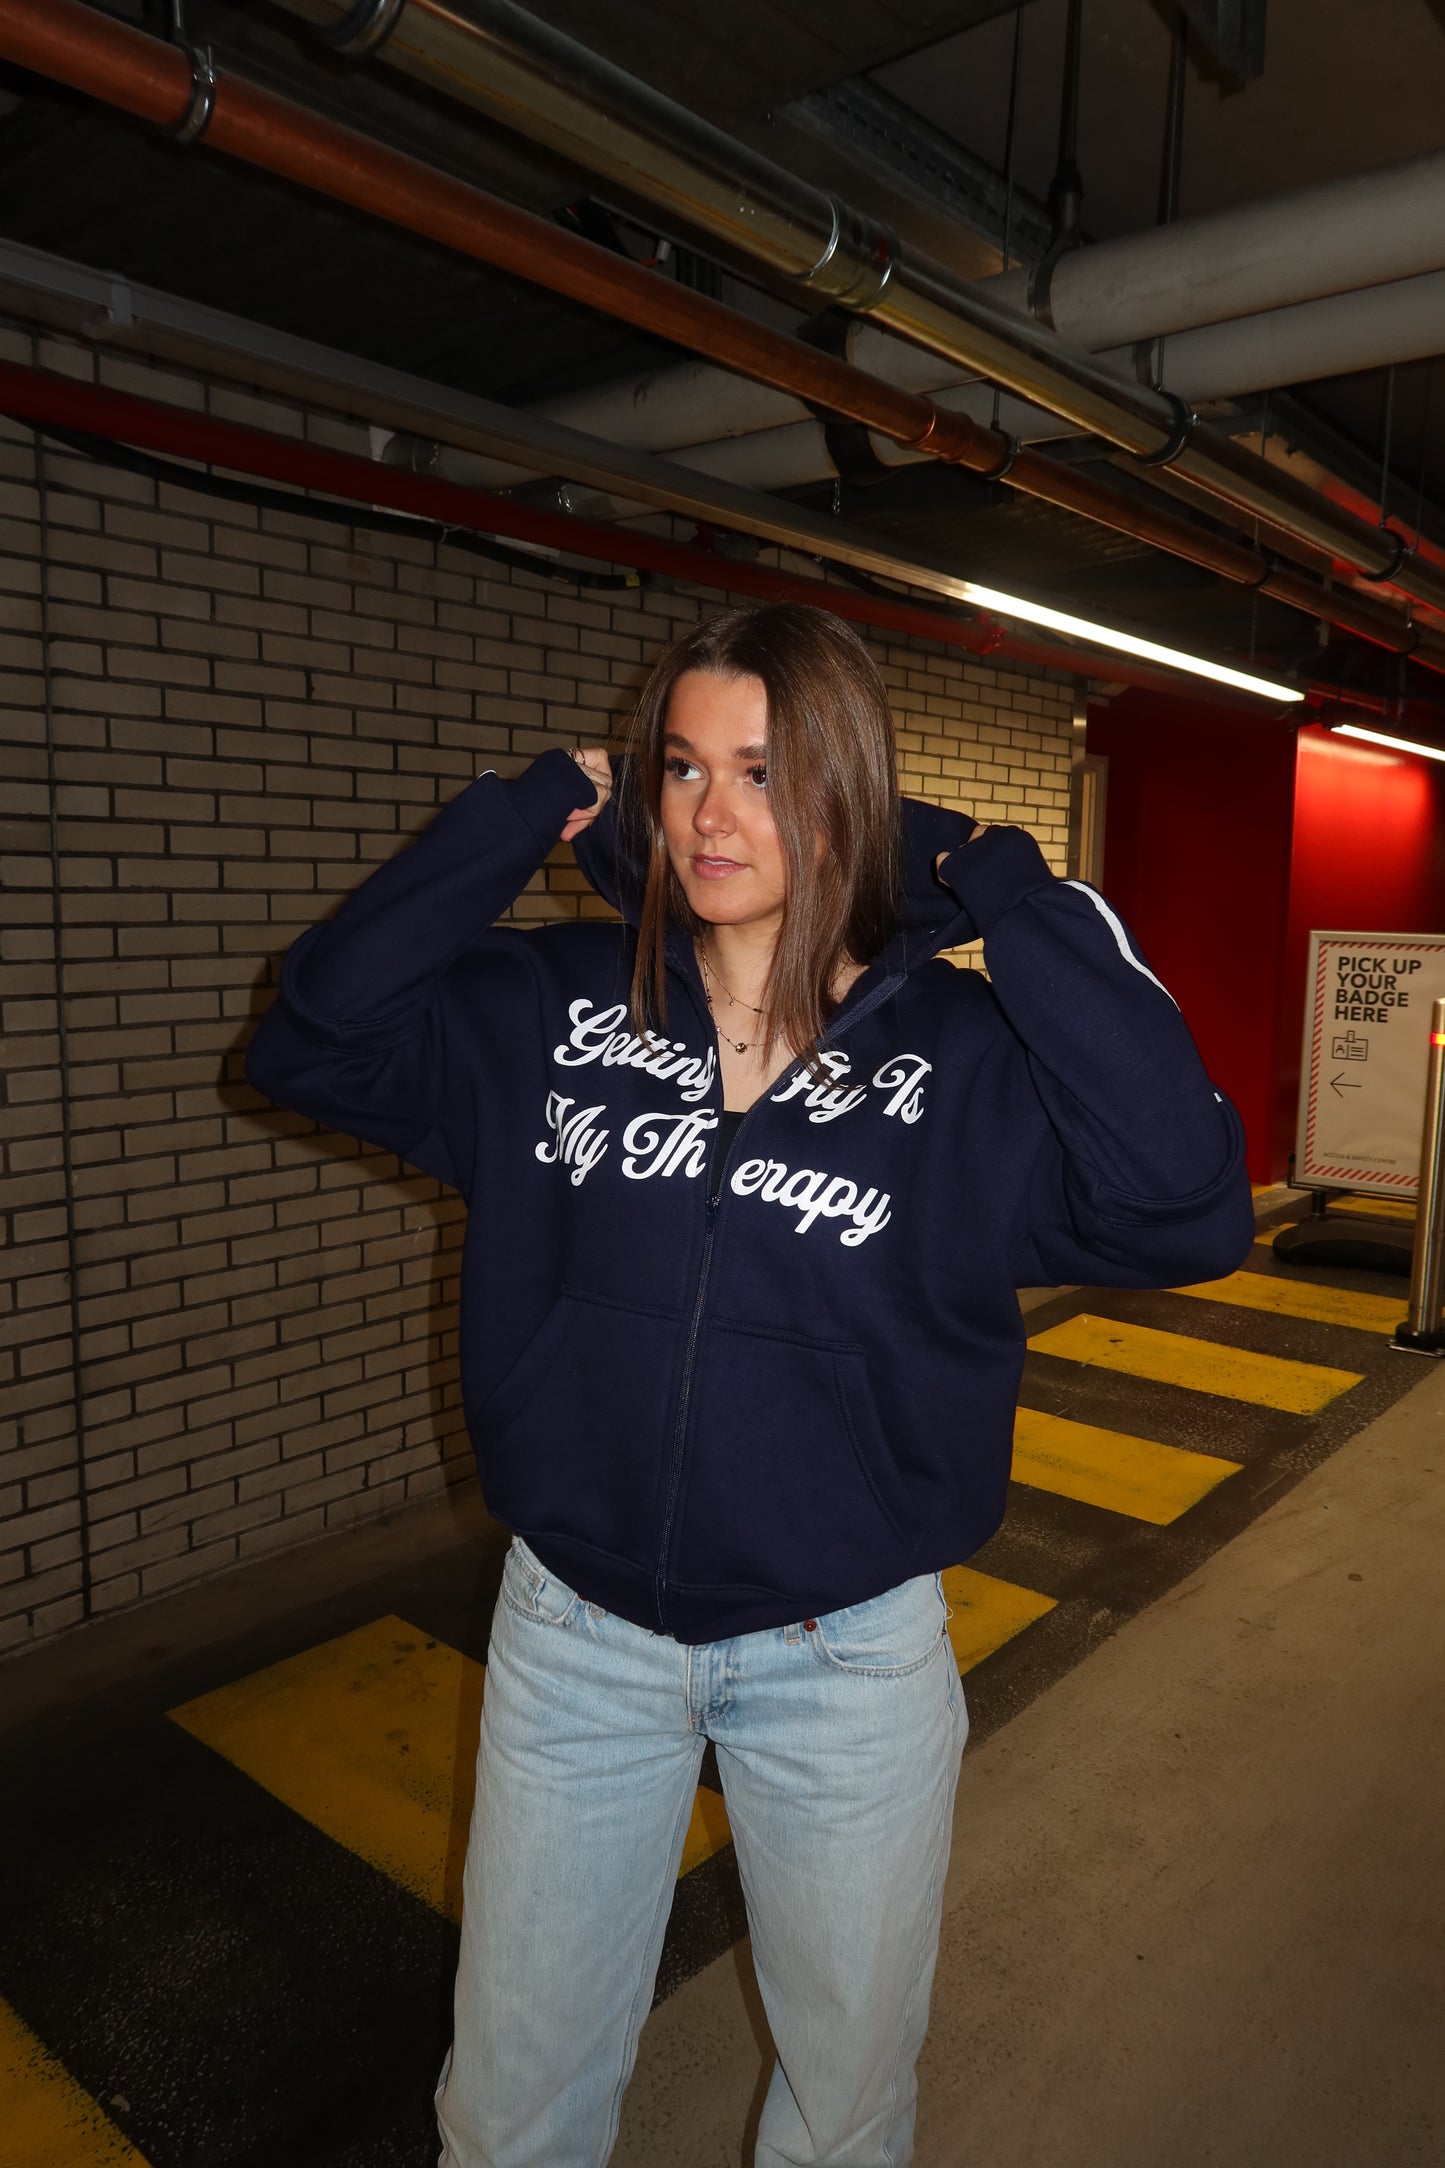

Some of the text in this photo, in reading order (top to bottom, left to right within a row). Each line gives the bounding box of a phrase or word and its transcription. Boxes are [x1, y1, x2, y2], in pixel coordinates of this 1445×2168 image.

[1338, 956, 1422, 975] PICK UP
[1336, 972, 1397, 990] YOUR
[1336, 989, 1409, 1007] BADGE
[1335, 1006, 1388, 1023] HERE
[553, 998, 717, 1102] Getting
[872, 1053, 933, 1125] Is
[534, 1089, 610, 1187] My
